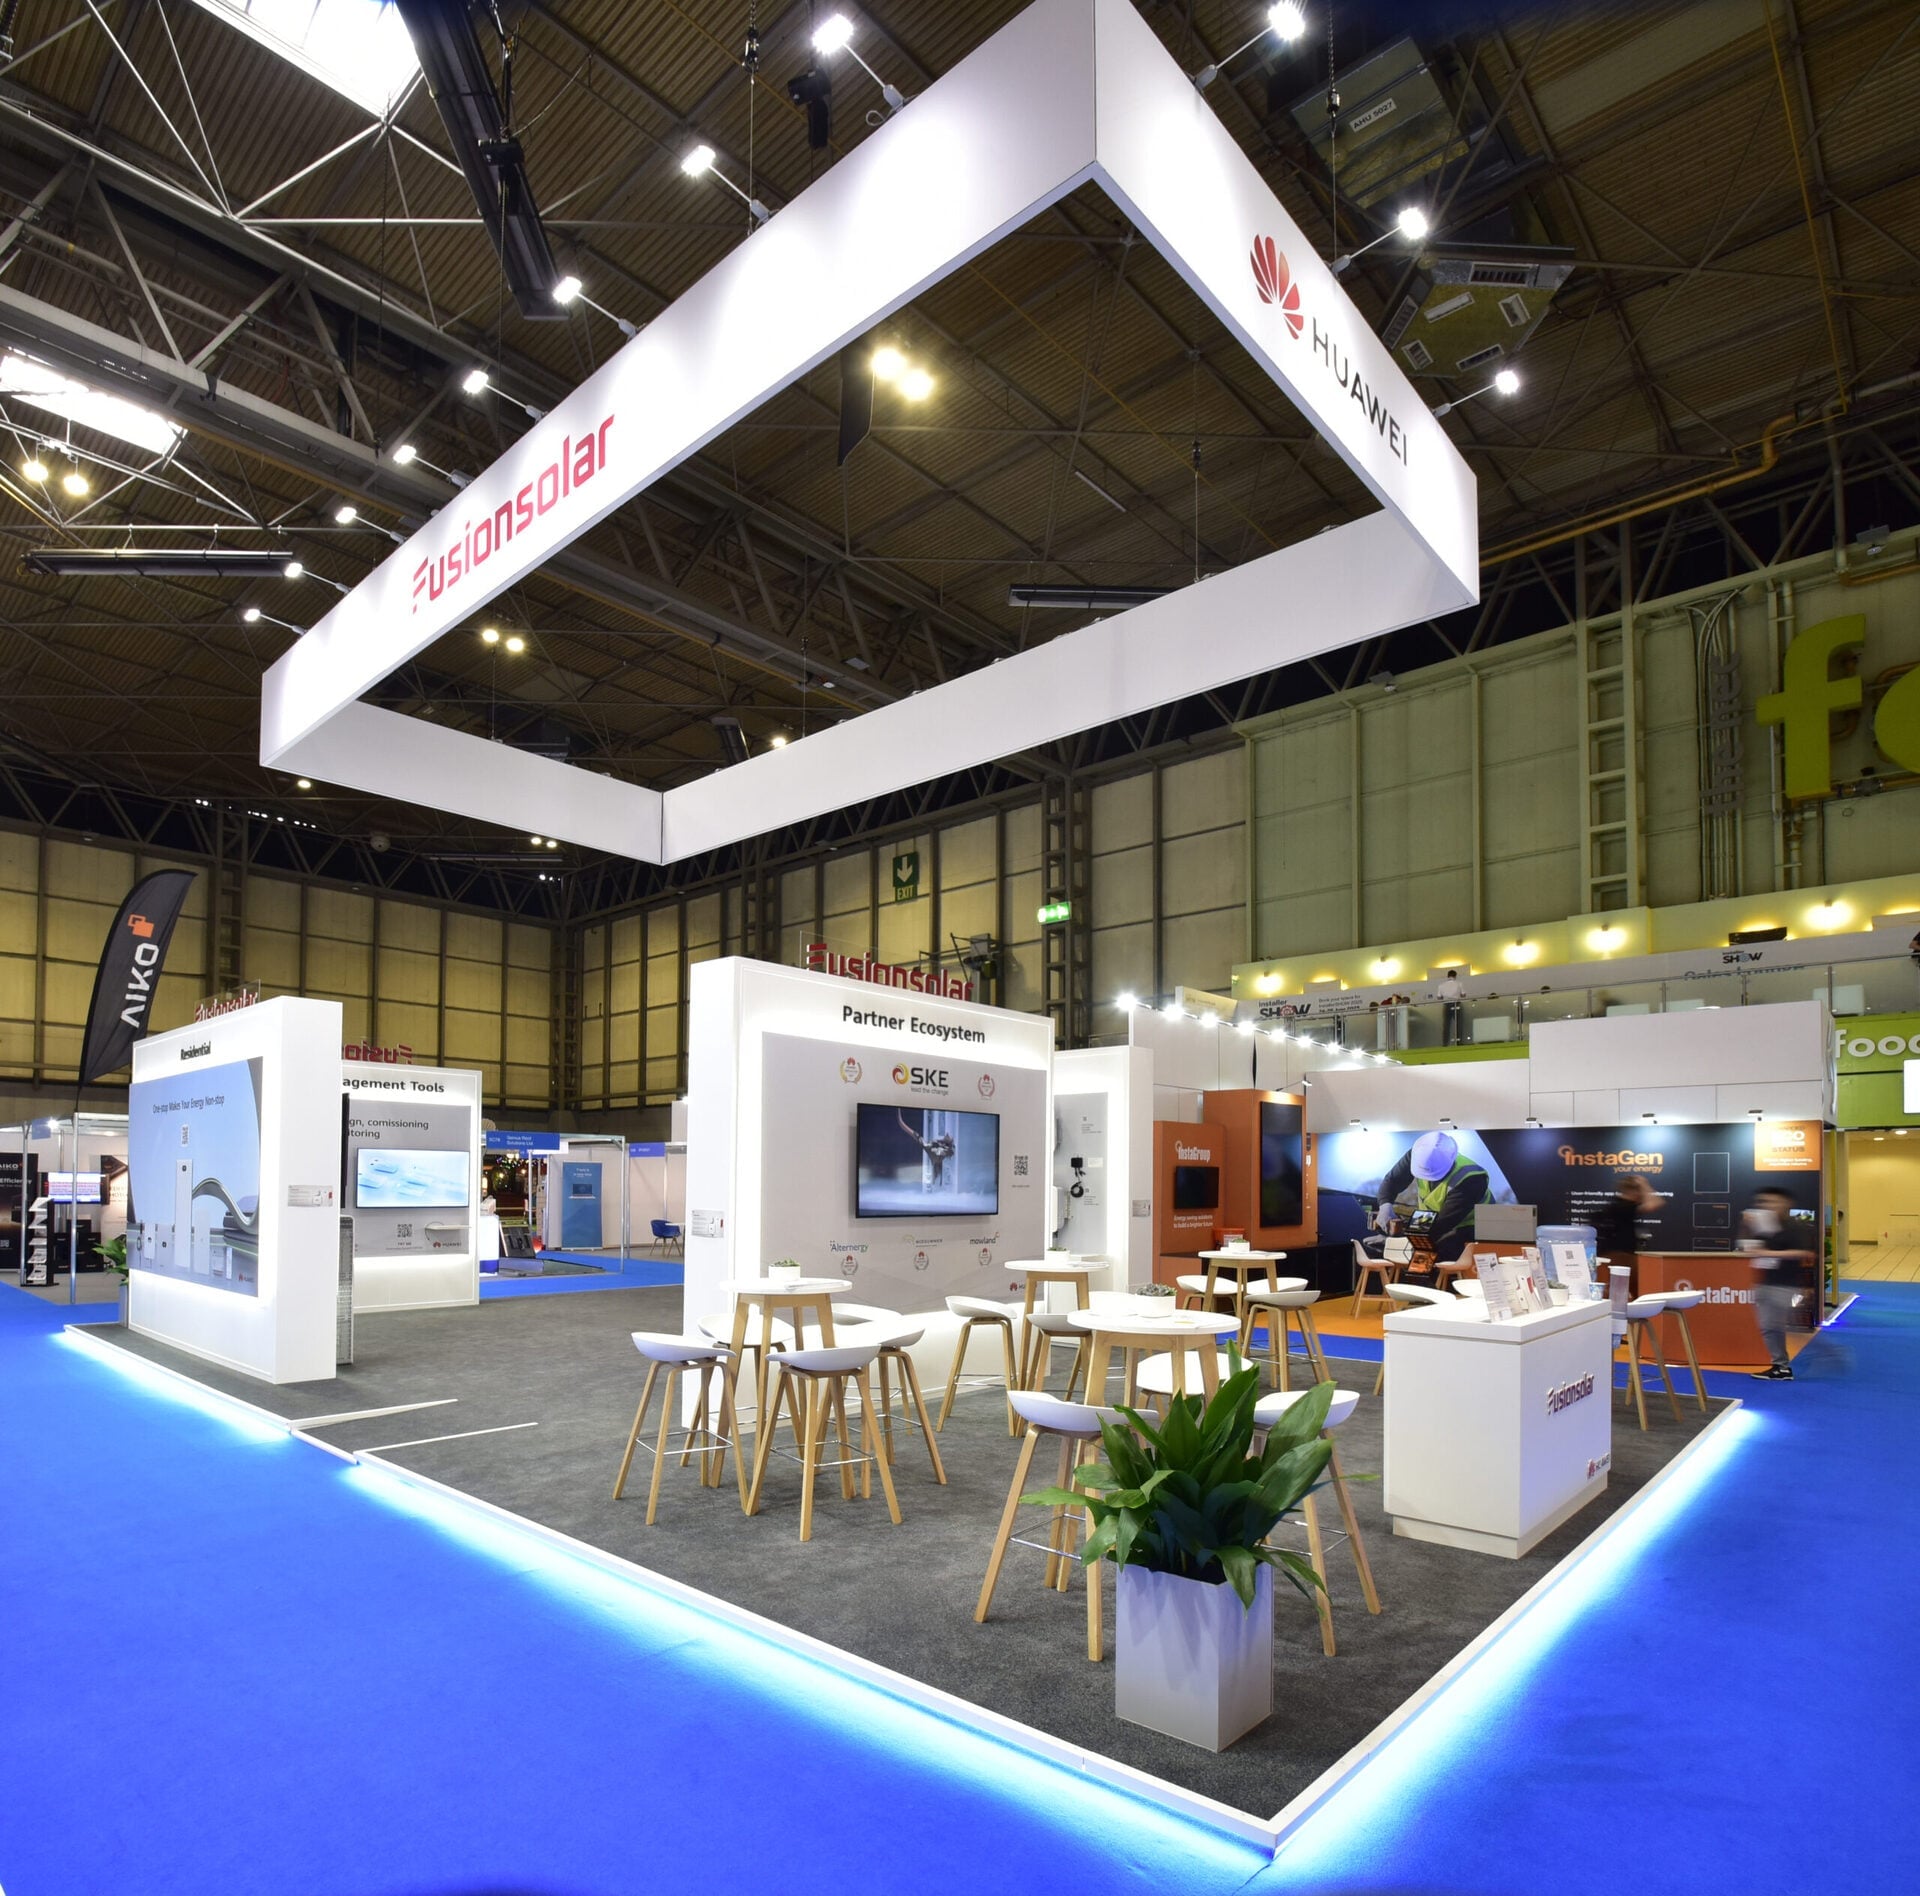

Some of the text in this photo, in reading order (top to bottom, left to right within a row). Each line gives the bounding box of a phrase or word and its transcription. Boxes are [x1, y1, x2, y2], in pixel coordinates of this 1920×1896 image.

[1353, 101, 1393, 129] AHU 5027
[1313, 316, 1408, 467] HUAWEI
[412, 413, 615, 615] Fusionsolar
[897, 886, 914, 899] EXIT
[120, 942, 160, 1028] AIKO
[1259, 1000, 1287, 1008] Installer
[1259, 1003, 1311, 1018] SHOW
[842, 1005, 986, 1044] Partner Ecosystem
[180, 1040, 212, 1060] Residential
[342, 1078, 445, 1093] agement Tools
[910, 1067, 950, 1088] SKE
[367, 1118, 429, 1131] comissioning
[1562, 1149, 1664, 1166] InstaGen
[830, 1242, 869, 1253] Alternergy
[970, 1235, 997, 1245] mowland
[1546, 1371, 1595, 1417] Fusionsolar
